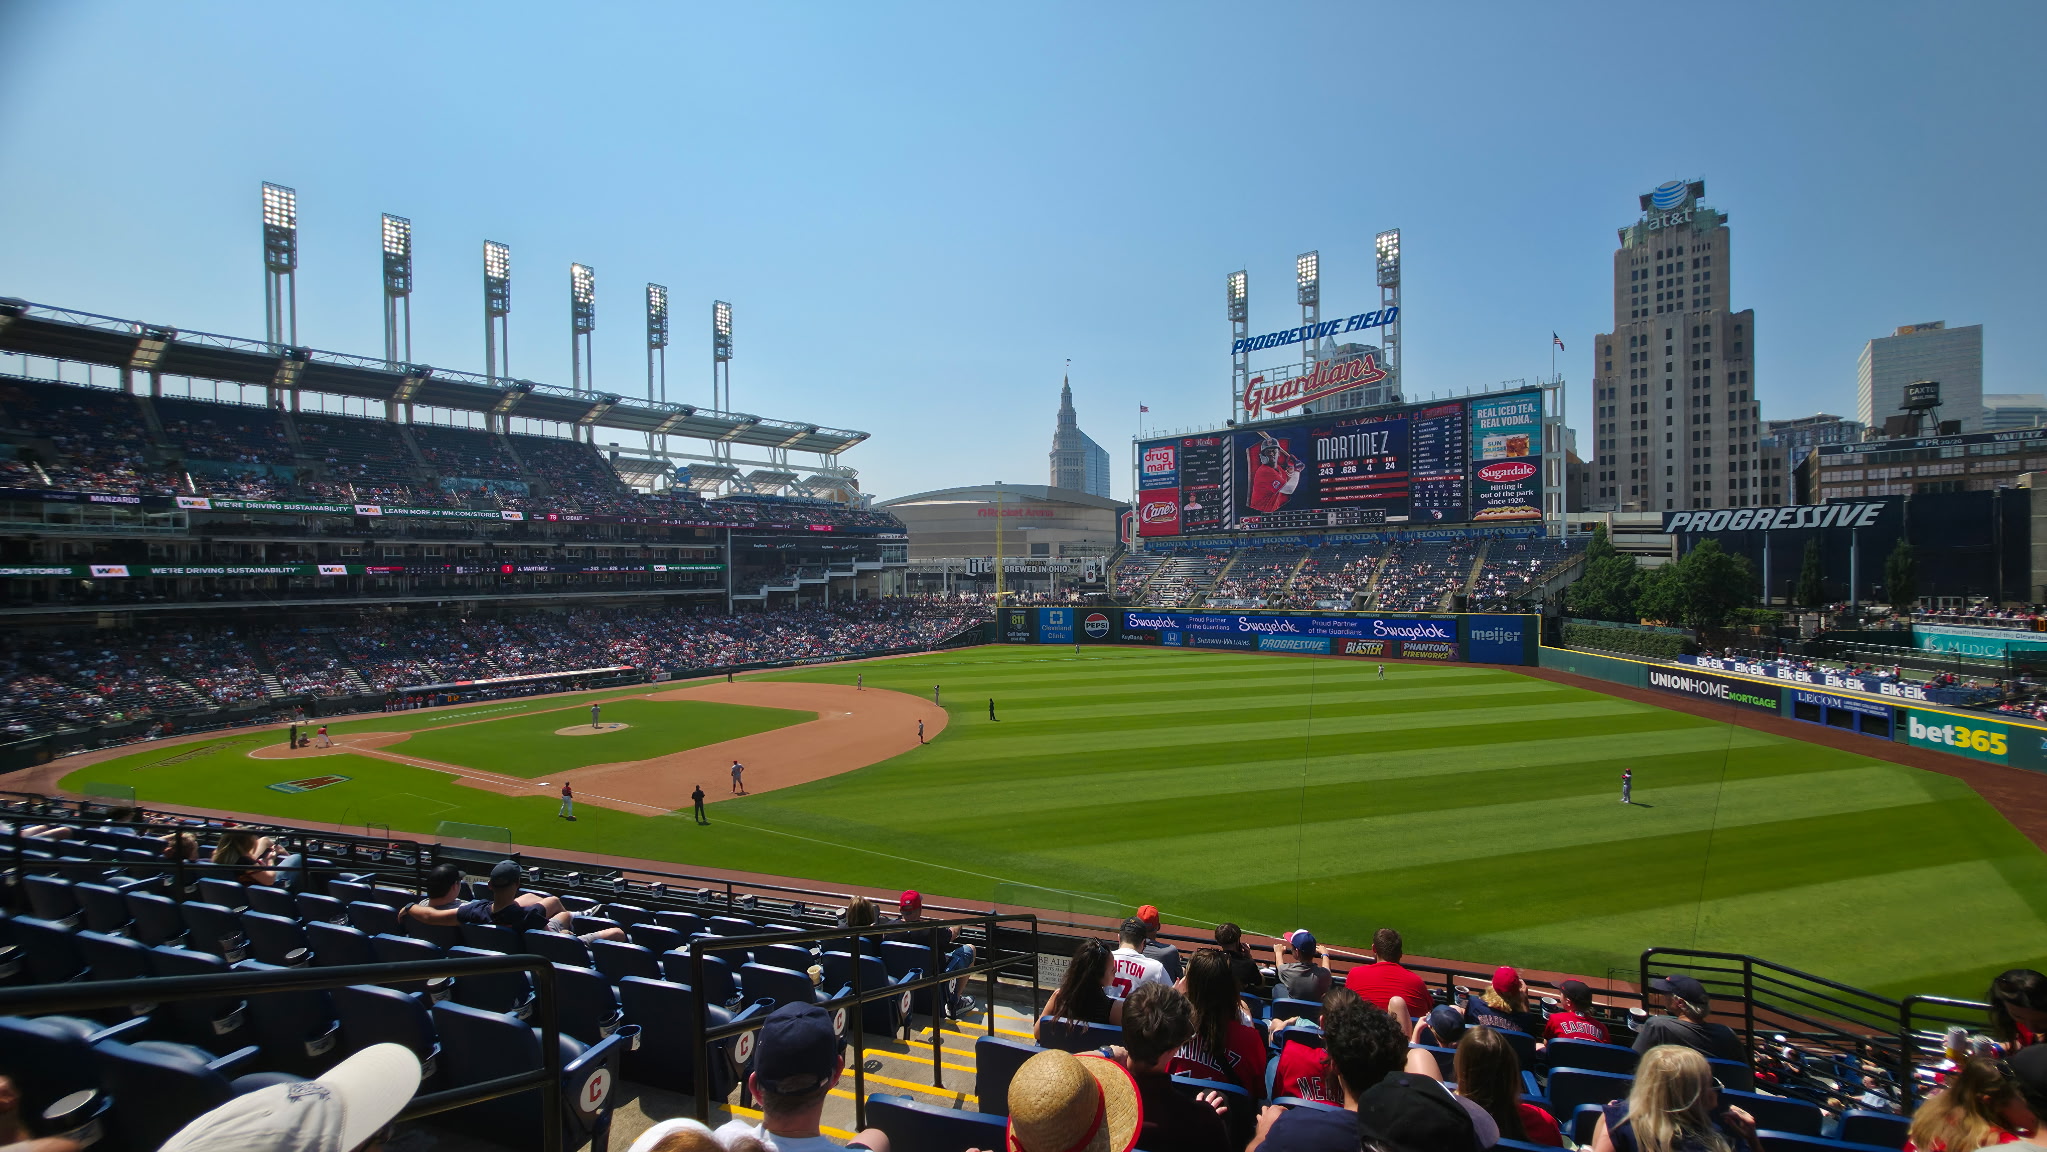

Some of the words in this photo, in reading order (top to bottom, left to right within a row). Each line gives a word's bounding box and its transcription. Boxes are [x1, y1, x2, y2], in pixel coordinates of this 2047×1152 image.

[1648, 206, 1693, 230] at&t
[1231, 318, 1343, 355] PROGRESSIVE
[1344, 307, 1399, 333] FIELD
[1243, 354, 1387, 419] Guardians
[1477, 407, 1497, 418] REAL
[1498, 405, 1517, 416] ICED
[1518, 403, 1536, 413] TEA.
[1481, 418, 1501, 429] REAL
[1501, 414, 1532, 427] VODKA.
[1144, 448, 1170, 463] drug
[1146, 461, 1173, 473] mart
[1318, 467, 1334, 476] .243
[1341, 466, 1357, 474] .626
[1385, 462, 1395, 470] 24
[1481, 466, 1533, 479] Sugardale
[1490, 483, 1515, 491] Hitting
[1516, 489, 1533, 497] park
[90, 495, 140, 504] MANZARDO
[215, 501, 243, 509] WE'RE
[246, 502, 281, 510] DRIVING
[988, 508, 1024, 517] Rocket
[1142, 501, 1176, 523] Cane's
[1666, 503, 1885, 533] PROGRESSIVE
[1262, 536, 1302, 544] HONDA
[1335, 533, 1379, 541] HONDA
[1416, 530, 1466, 538] HONDA
[1479, 527, 1538, 536] HONDA
[965, 558, 993, 577] Lite
[1005, 565, 1036, 573] BREWED
[1038, 565, 1045, 573] IN
[1049, 565, 1067, 573] OHIO
[1012, 615, 1025, 625] 811
[1129, 613, 1180, 630] Swagelok
[1239, 616, 1300, 635] Swagelok
[1329, 628, 1362, 636] Guardians
[1373, 619, 1450, 640] Swagelok
[1471, 626, 1521, 645] meijer
[1260, 638, 1326, 651] PROGRESSIVE
[1345, 641, 1384, 656] BLASTER
[1403, 642, 1448, 652] PHANTOM
[1402, 651, 1449, 660] FIREWORKS
[1729, 692, 1777, 708] MORTGAGE
[1909, 716, 2008, 755] bet365
[1112, 977, 1132, 998] 7
[740, 1035, 749, 1057] C
[589, 1075, 602, 1103] C
